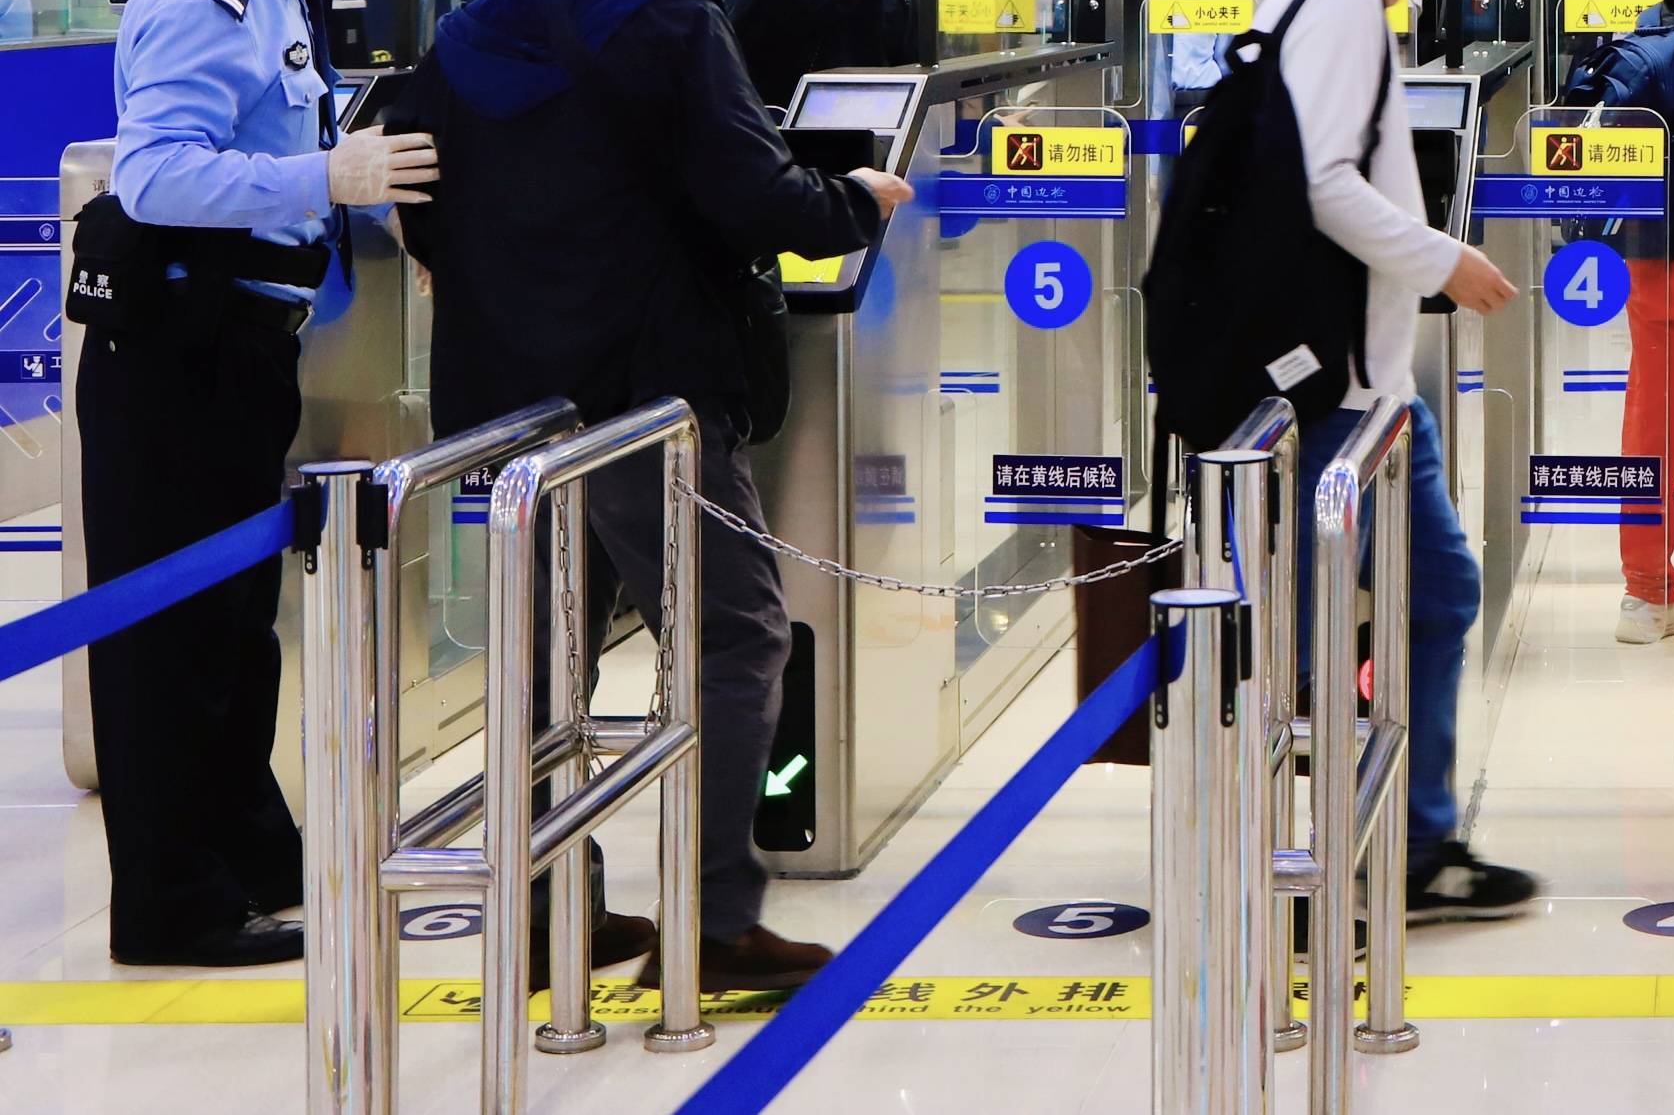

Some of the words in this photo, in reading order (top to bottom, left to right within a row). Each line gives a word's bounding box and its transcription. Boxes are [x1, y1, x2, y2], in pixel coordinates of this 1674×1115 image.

[1195, 6, 1241, 20] 小心夹手
[1048, 143, 1115, 163] 请勿推门
[1588, 143, 1655, 164] 请勿推门
[78, 270, 110, 288] 警察
[1035, 262, 1064, 310] 5
[1563, 257, 1603, 309] 4
[72, 282, 113, 300] POLICE
[996, 463, 1118, 489] 请在黄线后候检
[1533, 464, 1656, 488] 请在黄线后候检
[403, 908, 482, 936] 6
[1047, 906, 1116, 934] 5
[953, 1004, 1003, 1014] the
[1026, 1004, 1132, 1015] yellow
